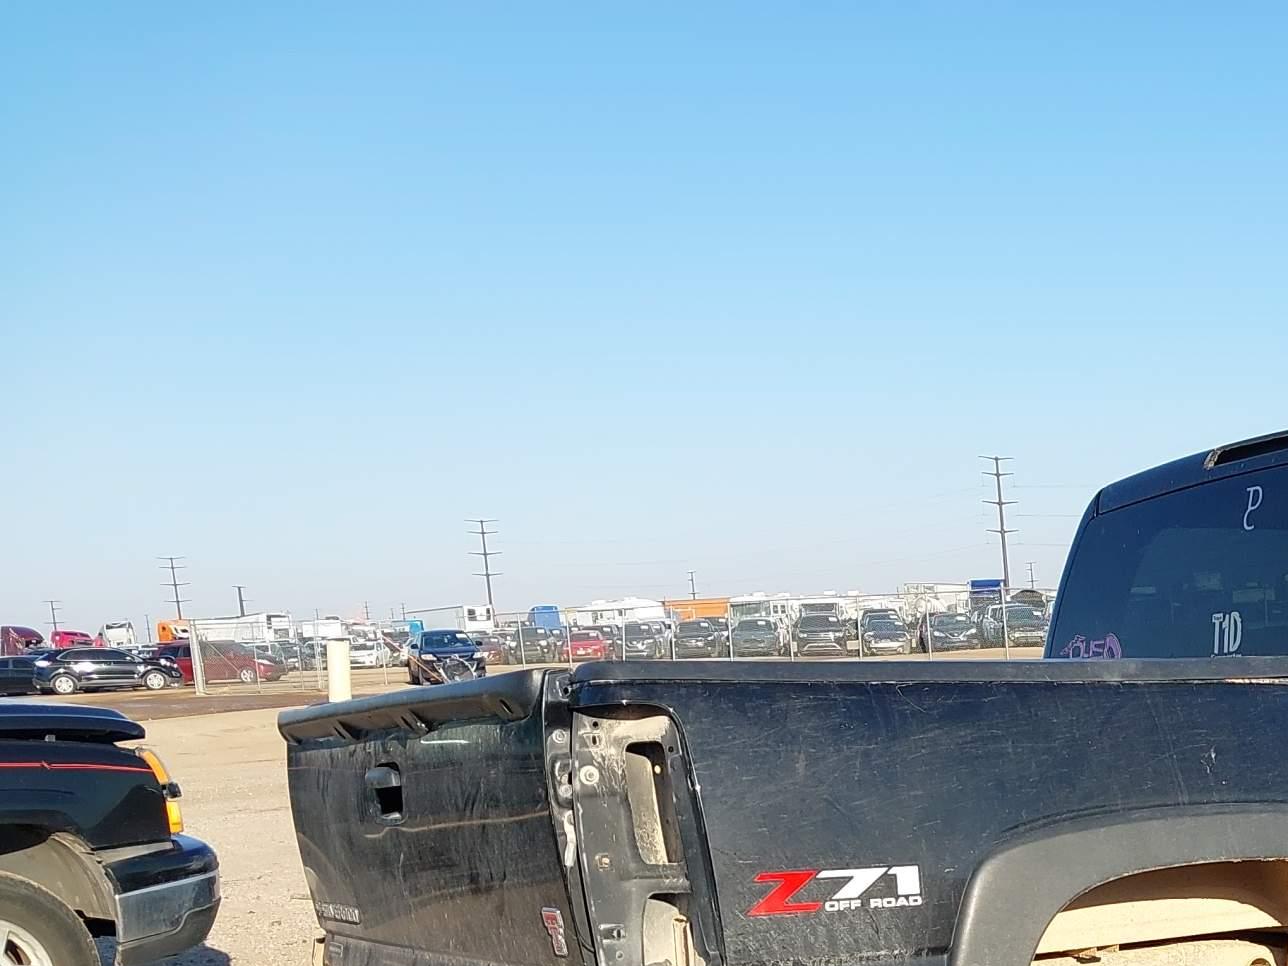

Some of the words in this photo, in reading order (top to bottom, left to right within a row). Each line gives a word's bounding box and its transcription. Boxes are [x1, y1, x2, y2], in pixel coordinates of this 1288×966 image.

[1212, 611, 1242, 654] T1D
[746, 864, 921, 916] Z71
[824, 899, 862, 913] OFF
[869, 895, 923, 909] ROAD
